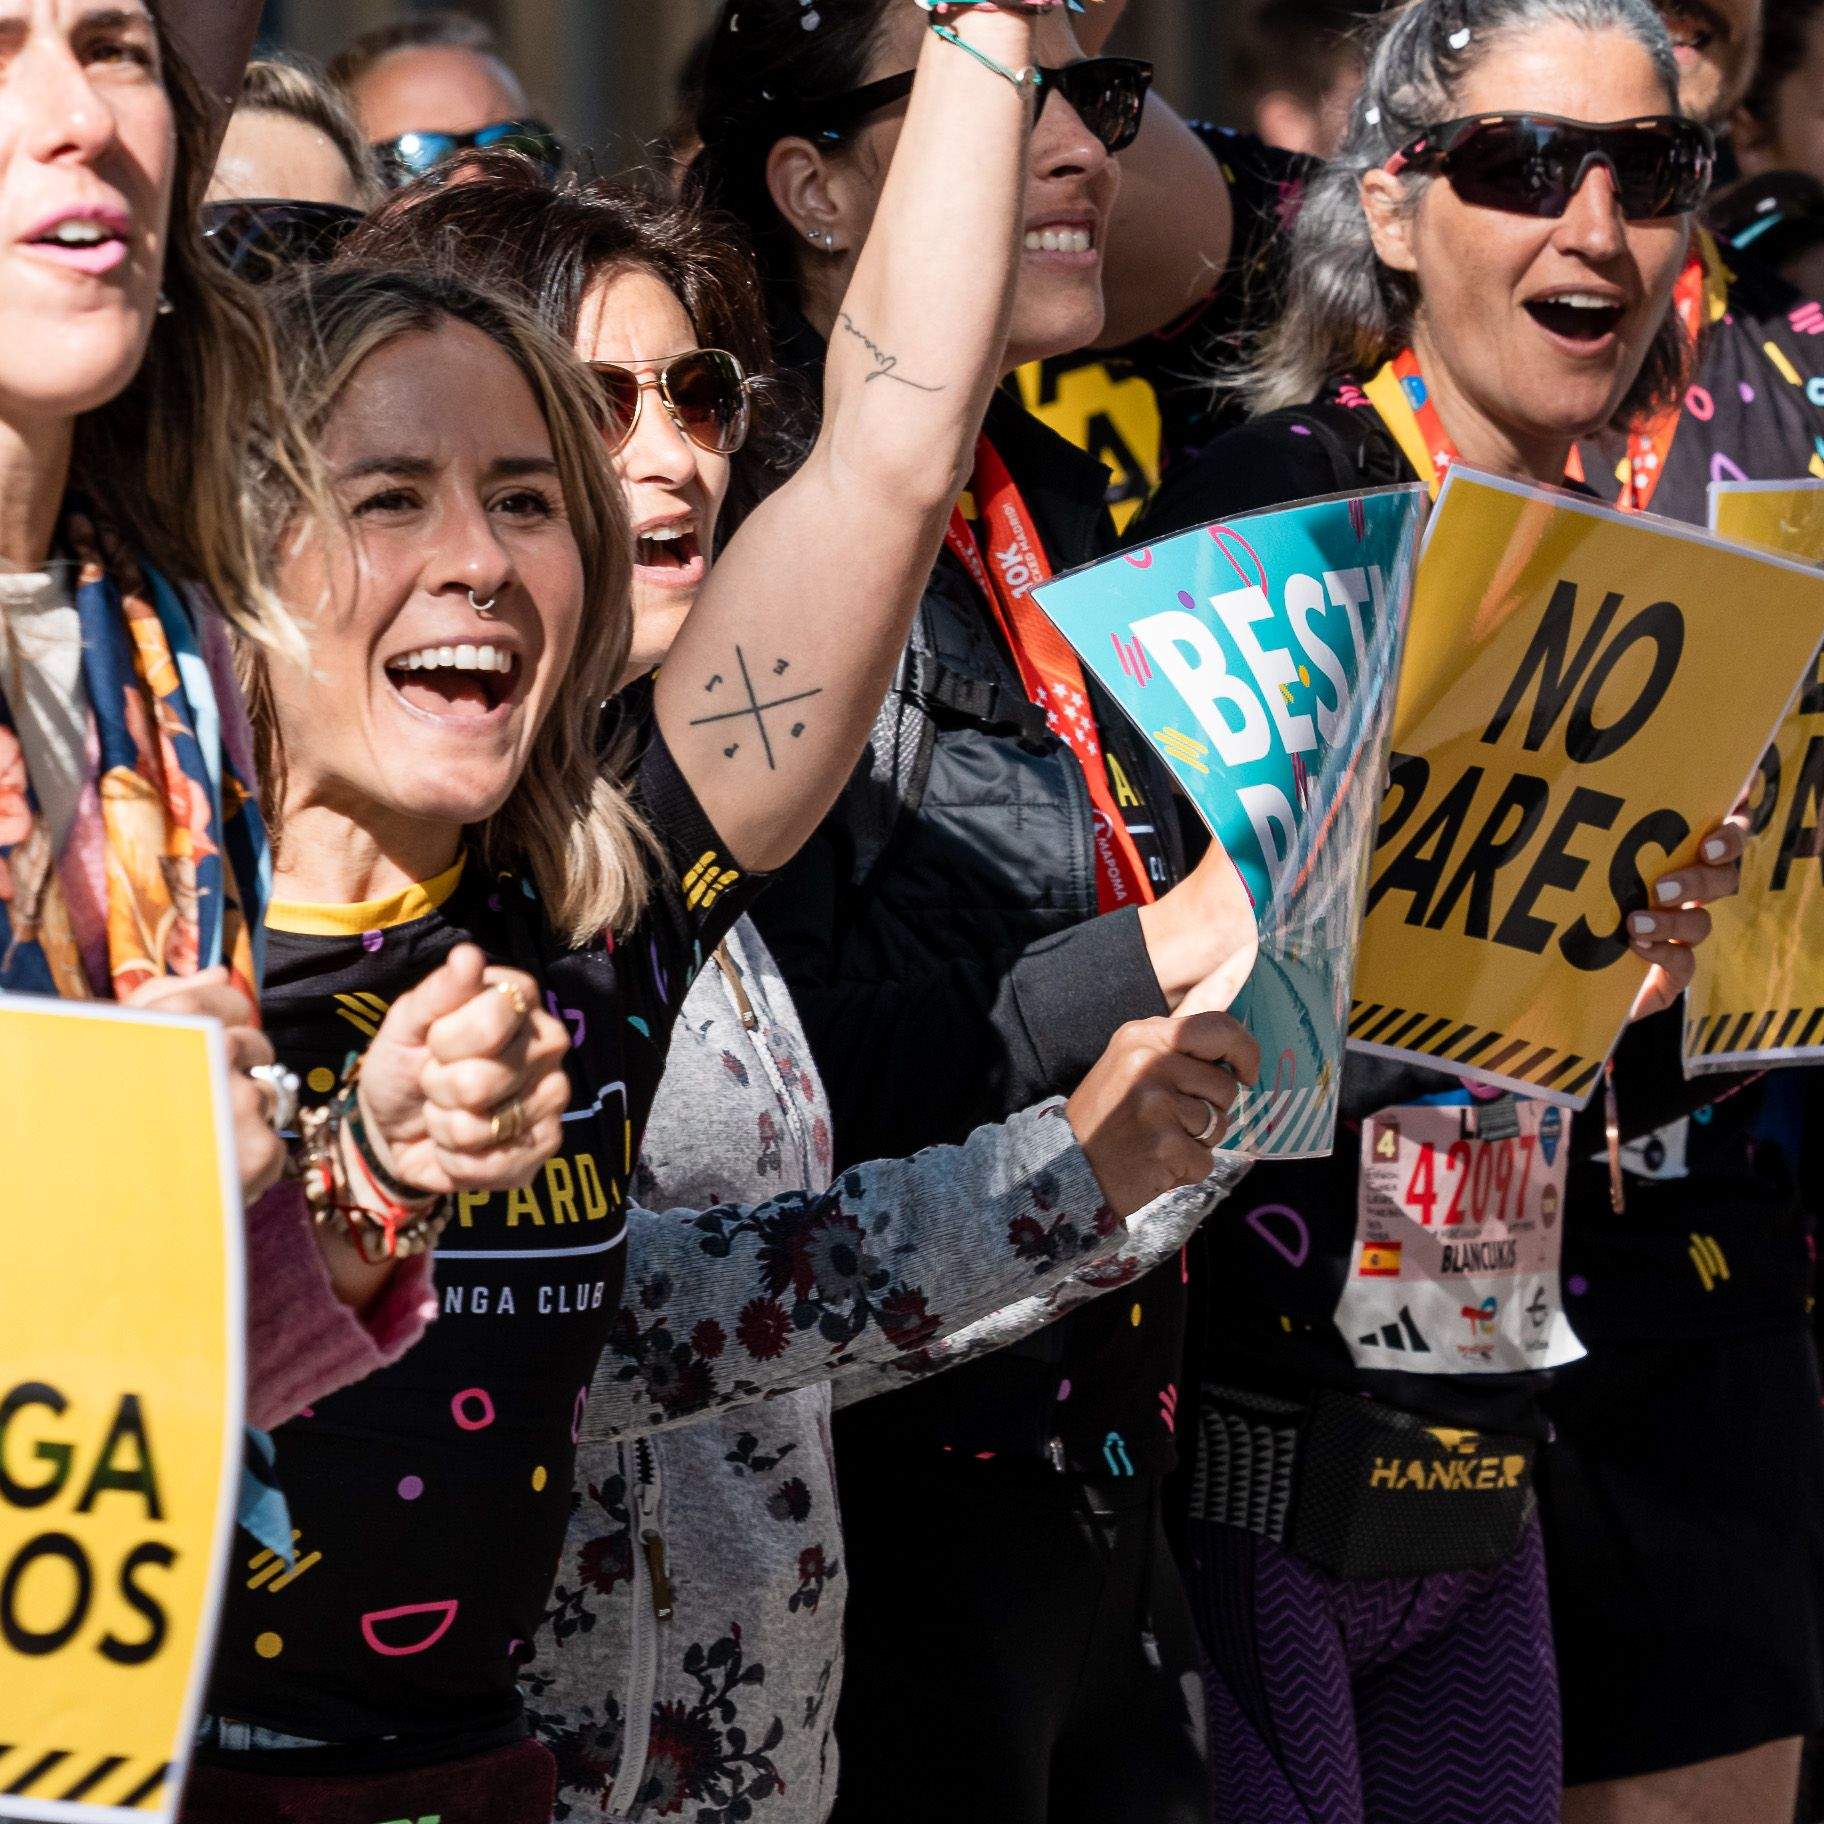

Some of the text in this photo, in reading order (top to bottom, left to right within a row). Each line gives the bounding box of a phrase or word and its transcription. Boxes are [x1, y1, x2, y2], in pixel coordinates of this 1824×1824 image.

[994, 541, 1033, 599] 10K
[1479, 579, 1686, 765] NO
[1364, 750, 1692, 972] PARES
[1376, 1127, 1397, 1158] 4
[457, 1152, 622, 1228] PARD
[1405, 1133, 1537, 1226] 42097
[537, 1280, 606, 1315] CLUB
[1369, 1453, 1527, 1491] HANKER
